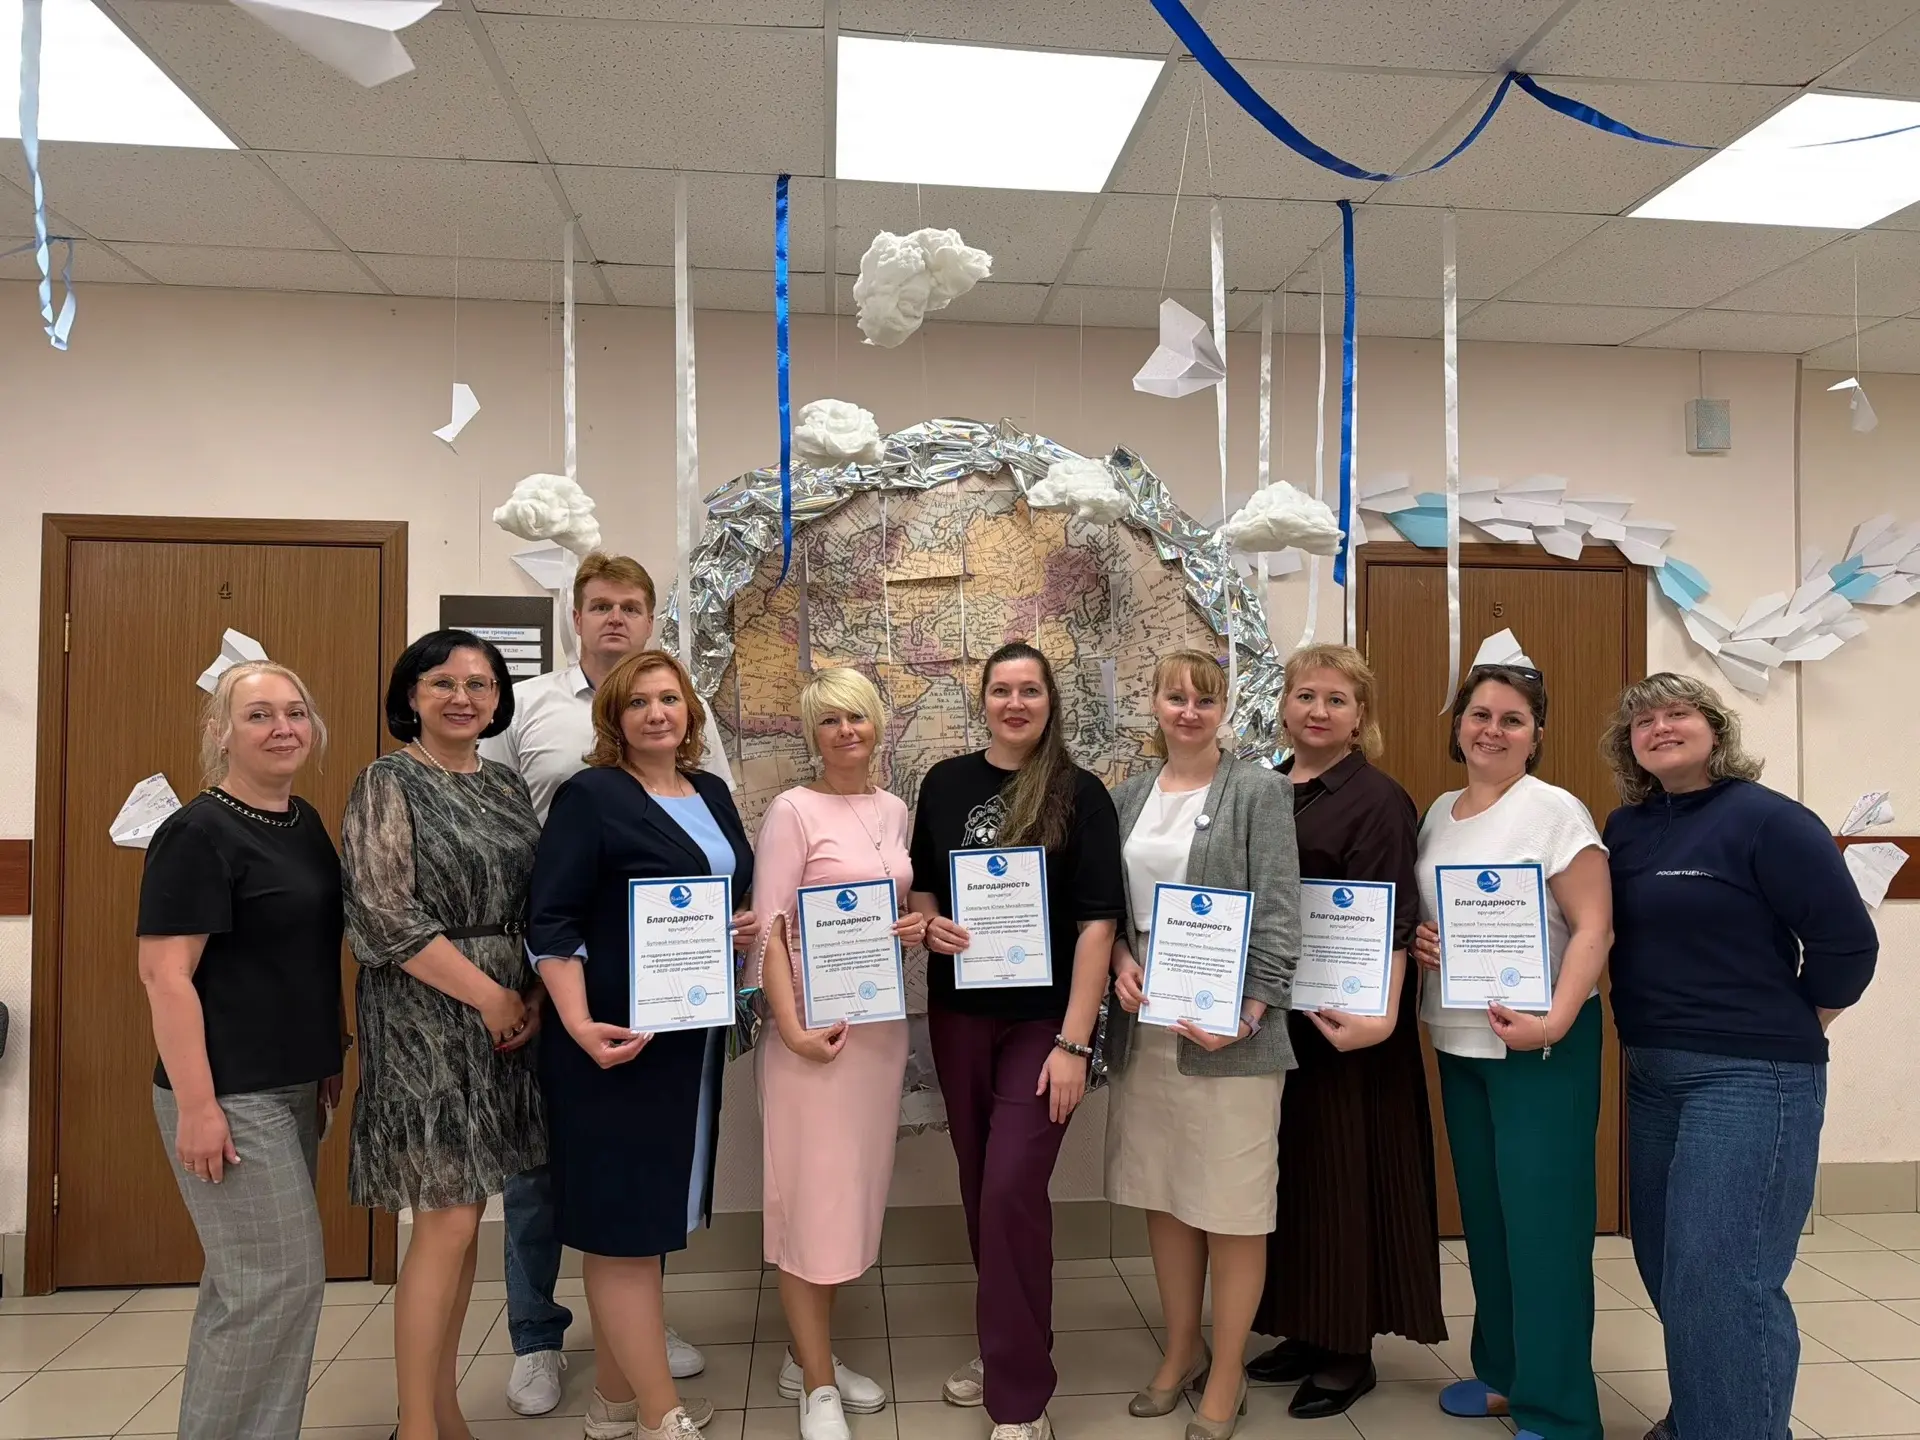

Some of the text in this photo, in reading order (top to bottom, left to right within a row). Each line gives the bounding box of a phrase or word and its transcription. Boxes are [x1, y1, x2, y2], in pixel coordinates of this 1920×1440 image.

[1492, 601, 1504, 618] 5
[967, 882, 1030, 890] Благодарность
[1455, 899, 1526, 907] Благодарность
[647, 914, 714, 924] Благодарность
[816, 915, 881, 927] Благодарность
[1310, 912, 1375, 922] Благодарность
[1167, 918, 1232, 931] Благодарность
